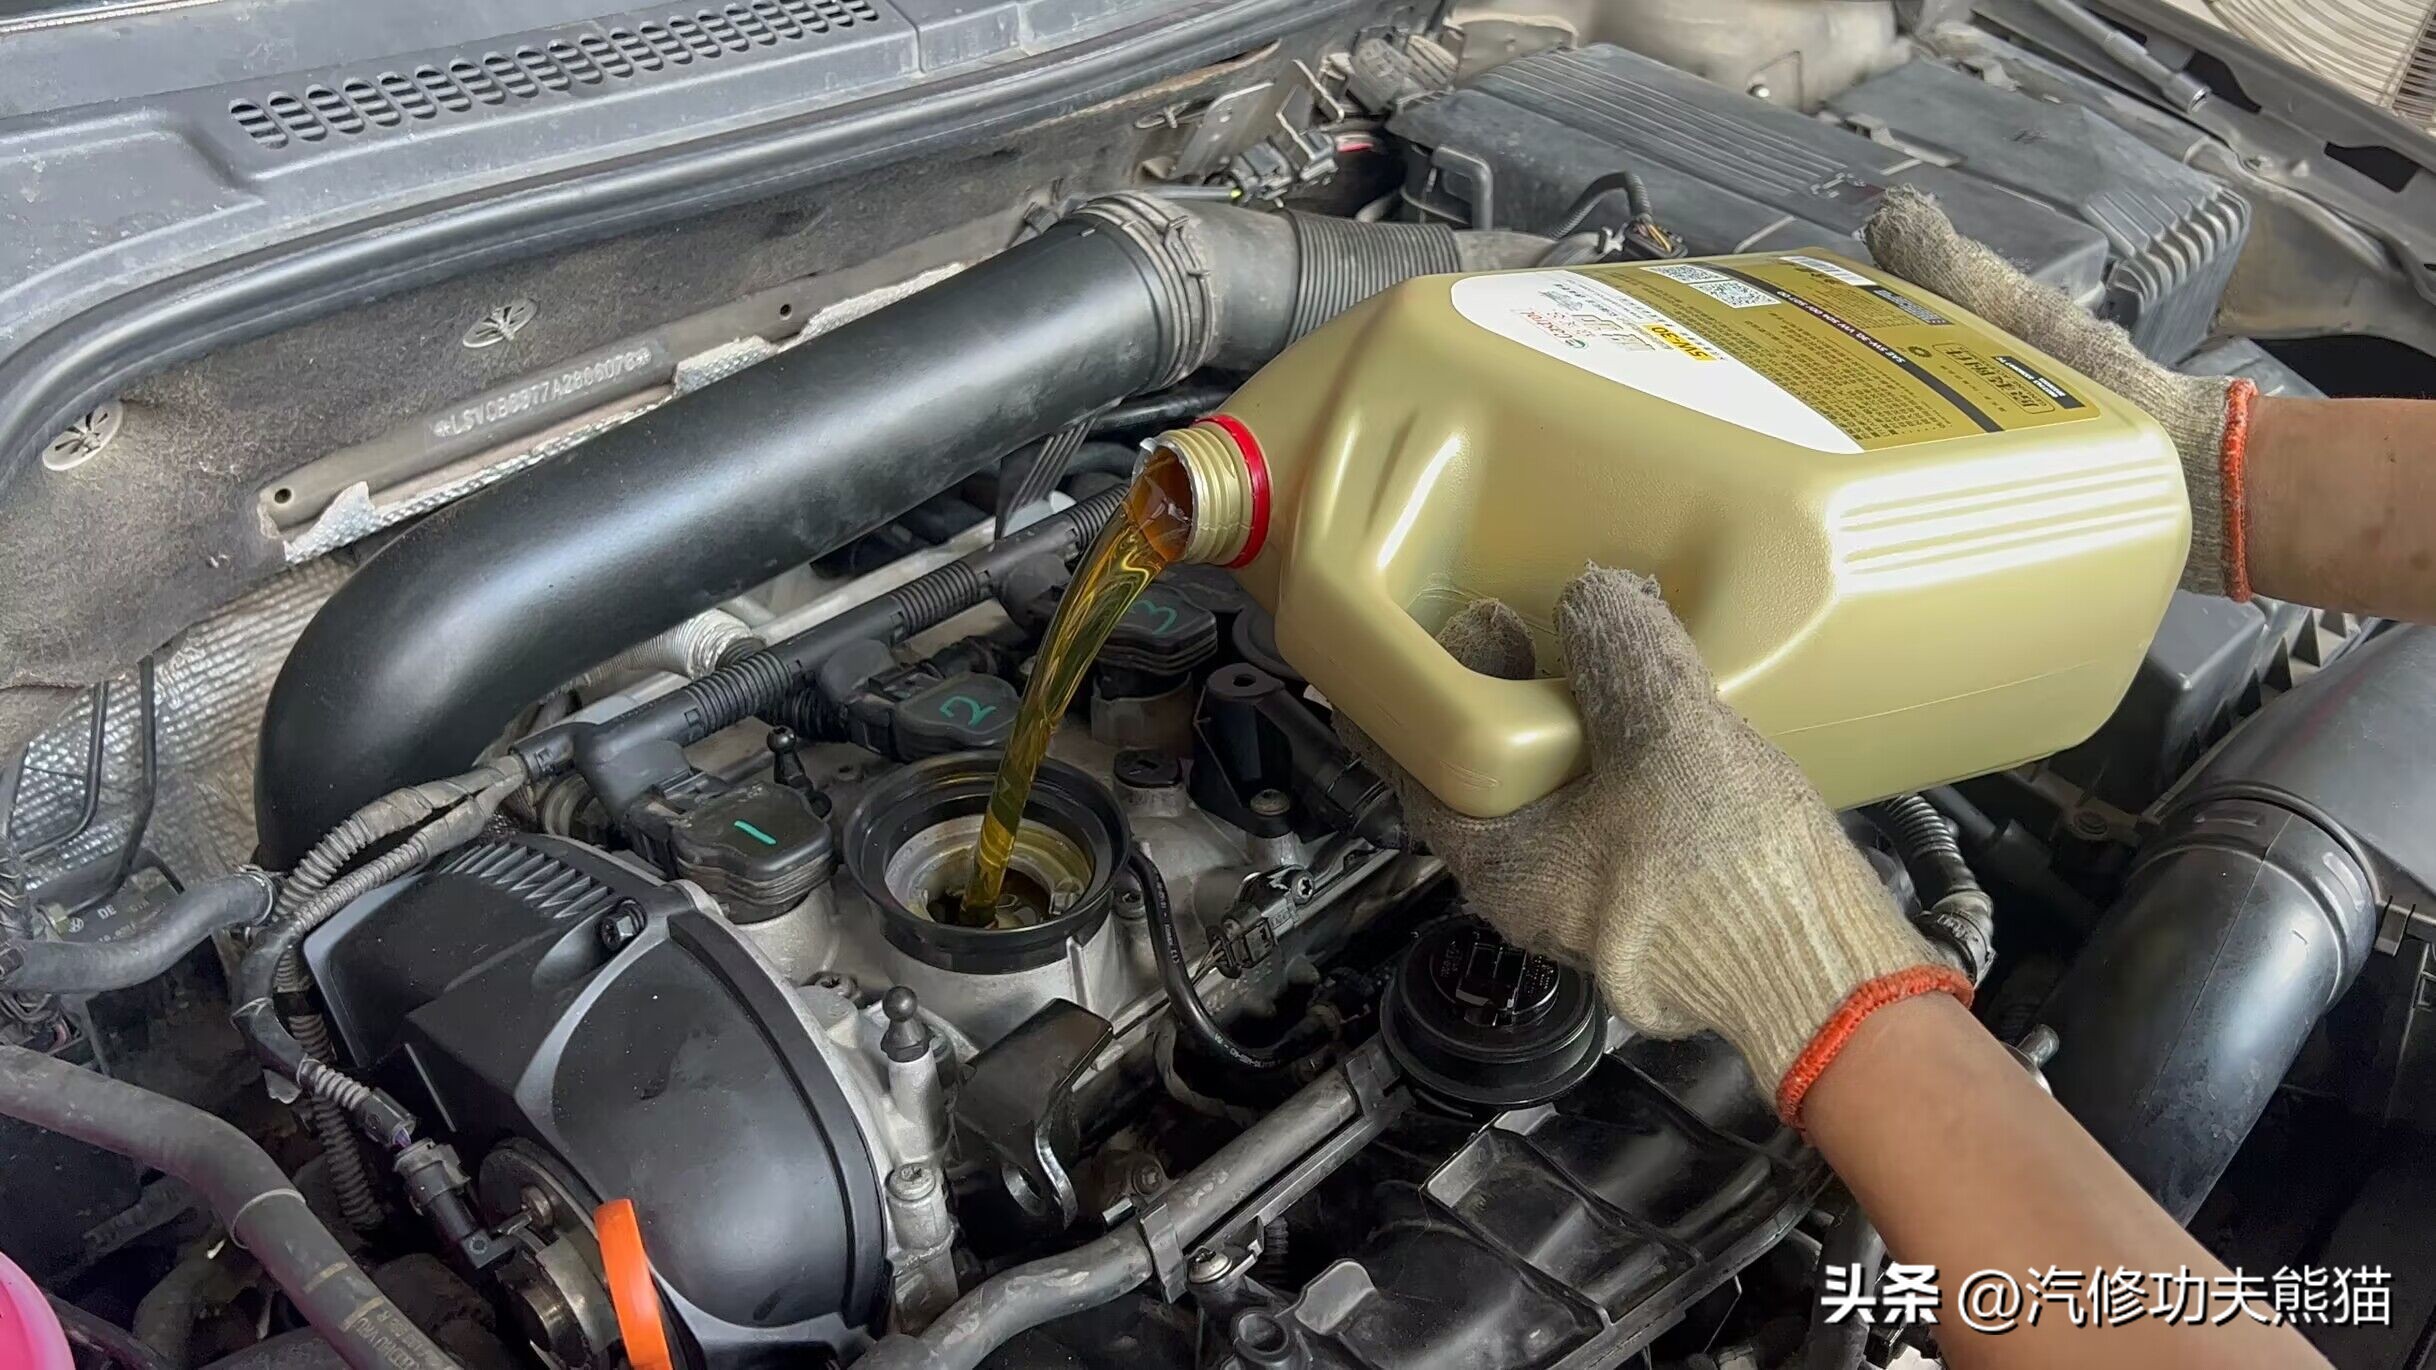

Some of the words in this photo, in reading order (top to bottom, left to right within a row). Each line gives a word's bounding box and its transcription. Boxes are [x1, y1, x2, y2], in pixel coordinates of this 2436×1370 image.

[1520, 308, 1573, 340] Castrol
[1651, 326, 1709, 359] 5W-30
[1884, 350, 1906, 364] SAE
[937, 696, 998, 727] 2
[97, 904, 117, 920] DE
